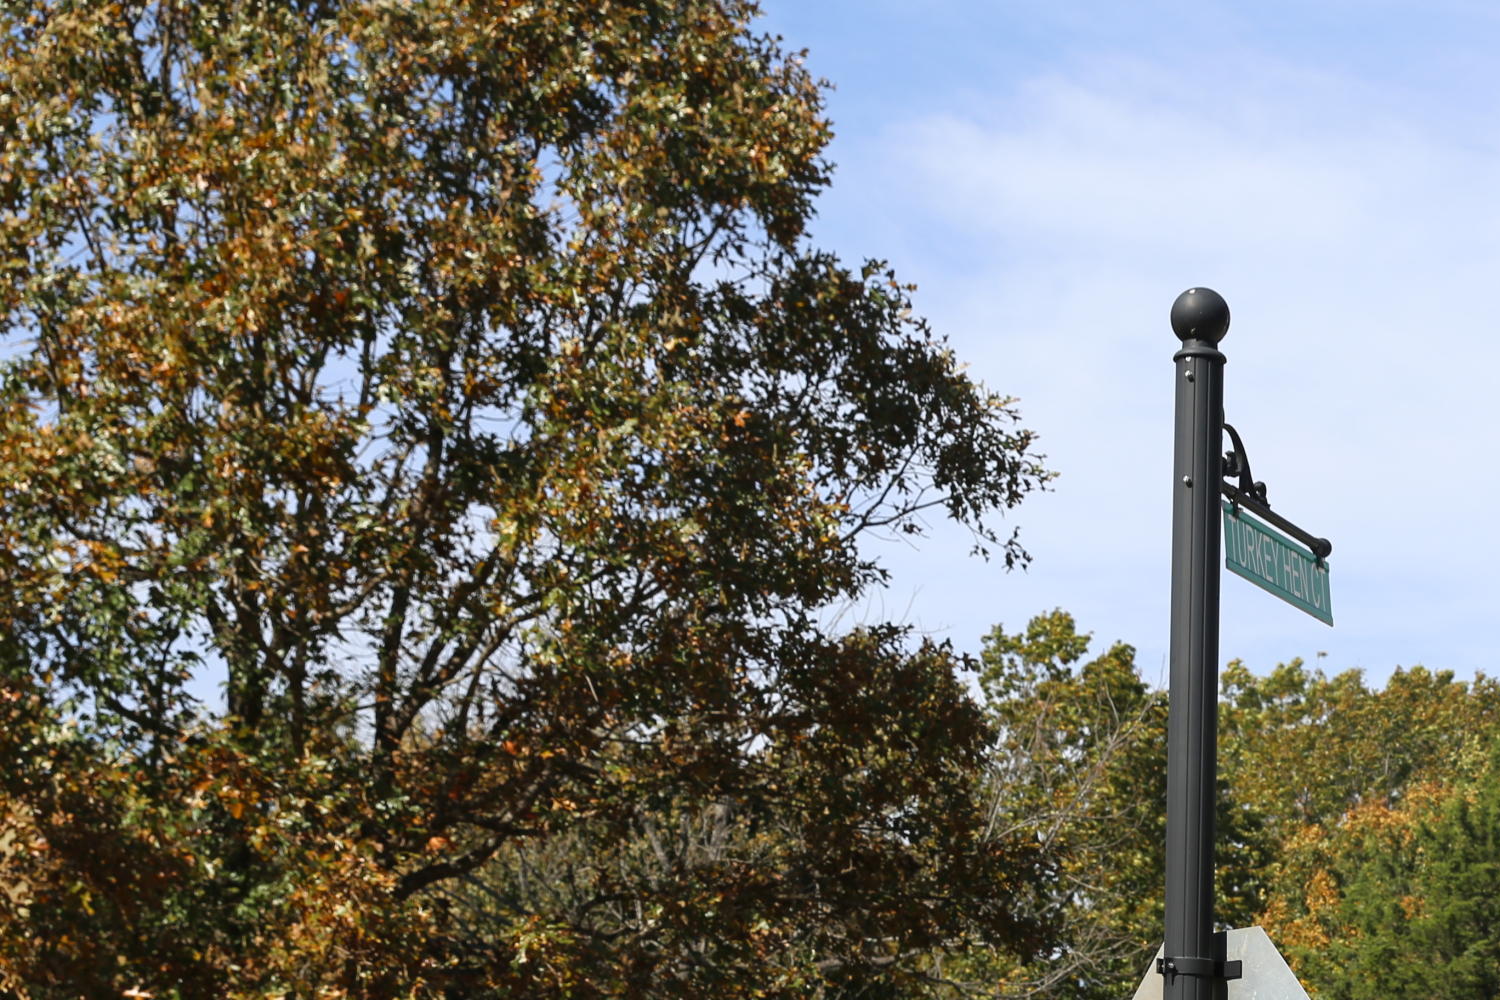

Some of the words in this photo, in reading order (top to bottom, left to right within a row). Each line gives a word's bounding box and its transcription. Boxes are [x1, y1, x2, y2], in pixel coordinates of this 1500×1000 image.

[1228, 514, 1279, 586] TURKEY
[1282, 544, 1309, 603] HEN
[1311, 563, 1327, 612] CT
